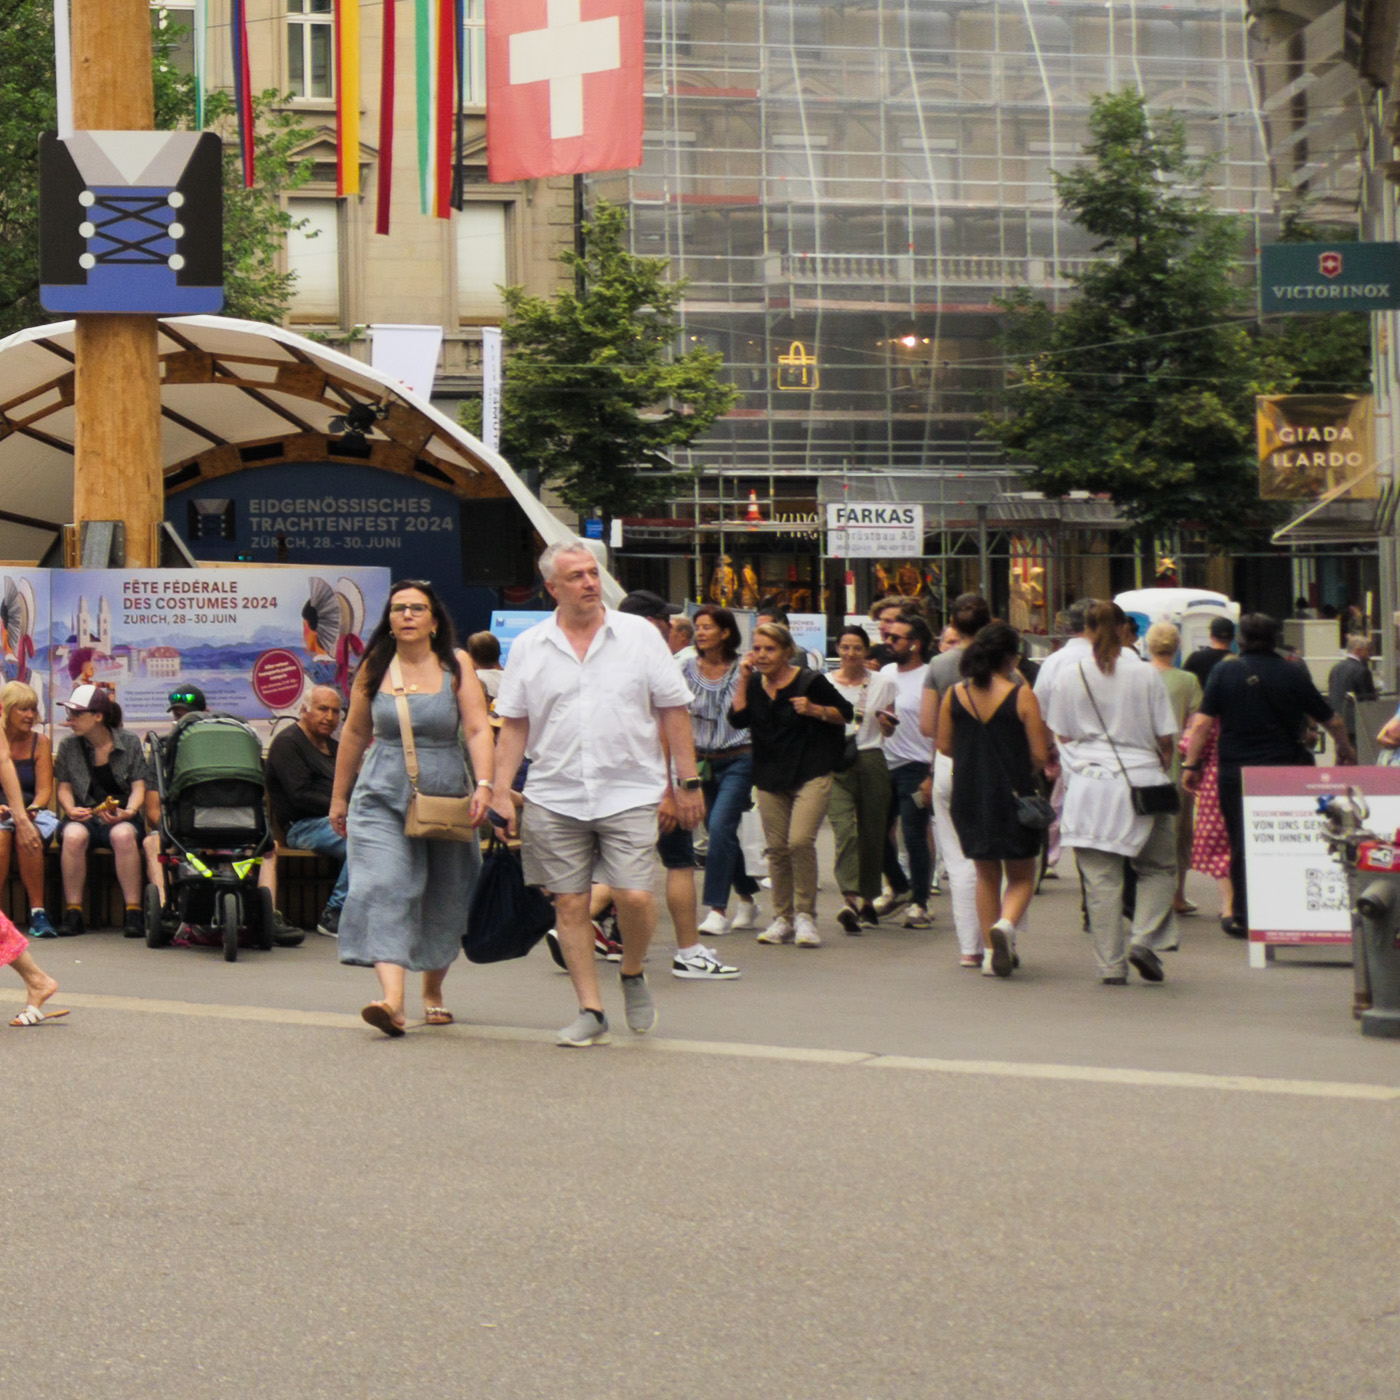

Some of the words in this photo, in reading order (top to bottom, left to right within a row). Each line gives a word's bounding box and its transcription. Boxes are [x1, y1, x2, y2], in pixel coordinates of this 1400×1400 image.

[1272, 284, 1390, 299] VICTORINOX
[1279, 426, 1354, 442] GIADA
[1272, 451, 1362, 468] ILARDO
[249, 496, 432, 514] EIDGENÖSSISCHES
[836, 508, 915, 524] FARKAS
[249, 517, 399, 531] TRACHTENFEST
[404, 516, 454, 531] 2024
[250, 535, 310, 549] ZÜRCH,
[366, 536, 402, 549] JUNI
[900, 530, 916, 541] AG
[123, 579, 159, 593] FÊTE
[163, 579, 238, 593] FÉDÉRALE
[123, 597, 151, 609] DES
[155, 597, 238, 609] COSTUMES
[241, 596, 278, 609] 2024
[123, 614, 170, 625] ZURICH,
[210, 614, 237, 624] JUIN
[1253, 820, 1274, 830] VON
[1278, 820, 1300, 830] UNS
[1253, 833, 1274, 843] VON
[1279, 833, 1311, 843] IHNEN
